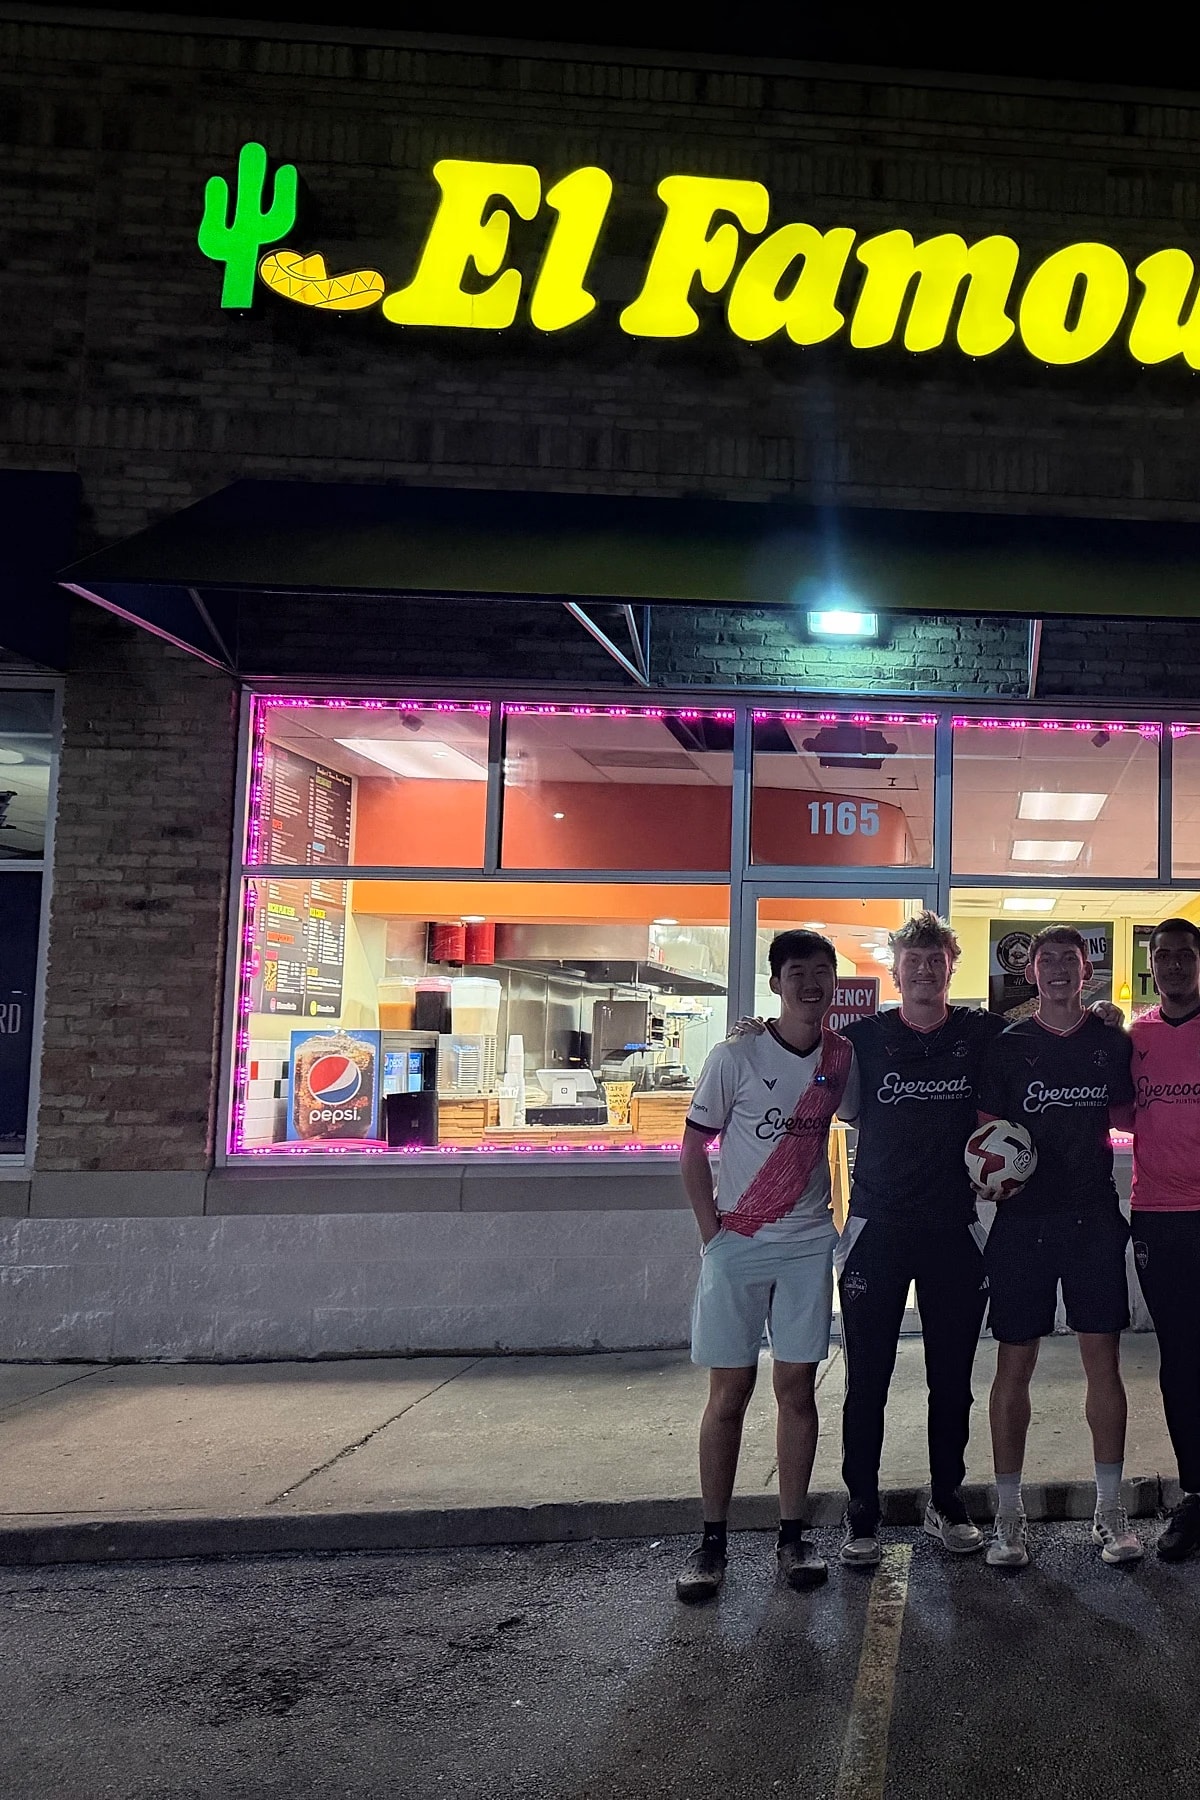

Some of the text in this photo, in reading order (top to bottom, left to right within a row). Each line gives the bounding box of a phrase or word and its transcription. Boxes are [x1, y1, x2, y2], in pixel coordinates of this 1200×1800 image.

[382, 158, 613, 331] El
[807, 801, 880, 836] 1165
[833, 988, 874, 1007] ENCY
[877, 1072, 973, 1105] Evercoat
[1023, 1080, 1109, 1113] Evercoat
